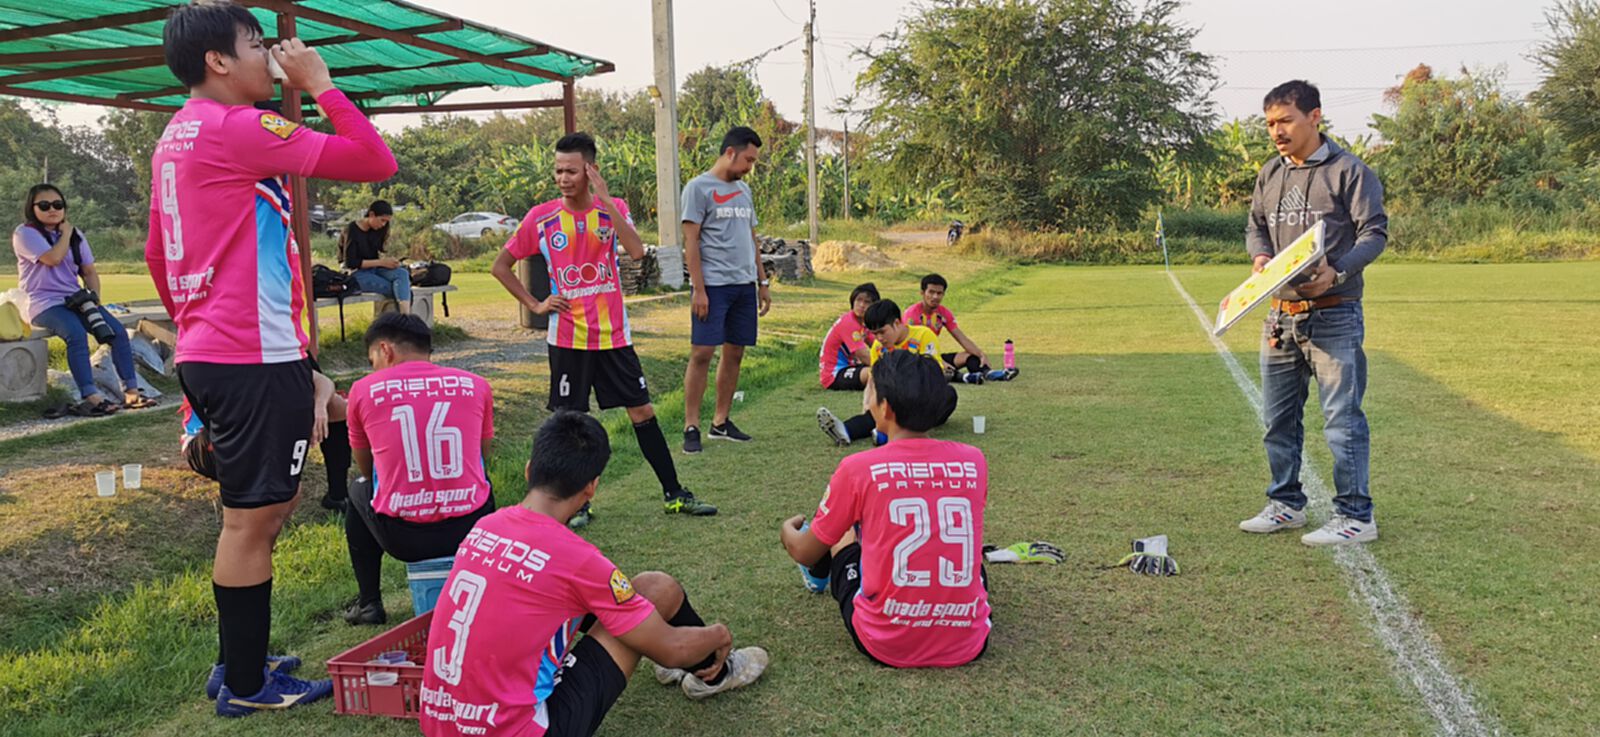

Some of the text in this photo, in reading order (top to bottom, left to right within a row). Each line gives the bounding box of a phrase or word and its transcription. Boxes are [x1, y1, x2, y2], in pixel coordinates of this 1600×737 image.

[161, 162, 184, 261] 9
[1269, 210, 1323, 228] SPORT
[557, 255, 614, 289] ICON
[370, 376, 475, 398] FRIENDS
[374, 388, 475, 406] PATHUM
[560, 374, 570, 397] 6
[391, 402, 464, 482] 16
[290, 439, 308, 476] 9
[869, 462, 978, 482] FRIENDS
[435, 484, 477, 508] sport
[877, 480, 978, 492] PATHUM
[466, 527, 551, 572] RIENDS
[889, 497, 975, 587] 29
[457, 547, 534, 583] ATHUM
[932, 597, 979, 618] sport
[433, 569, 487, 686] 3
